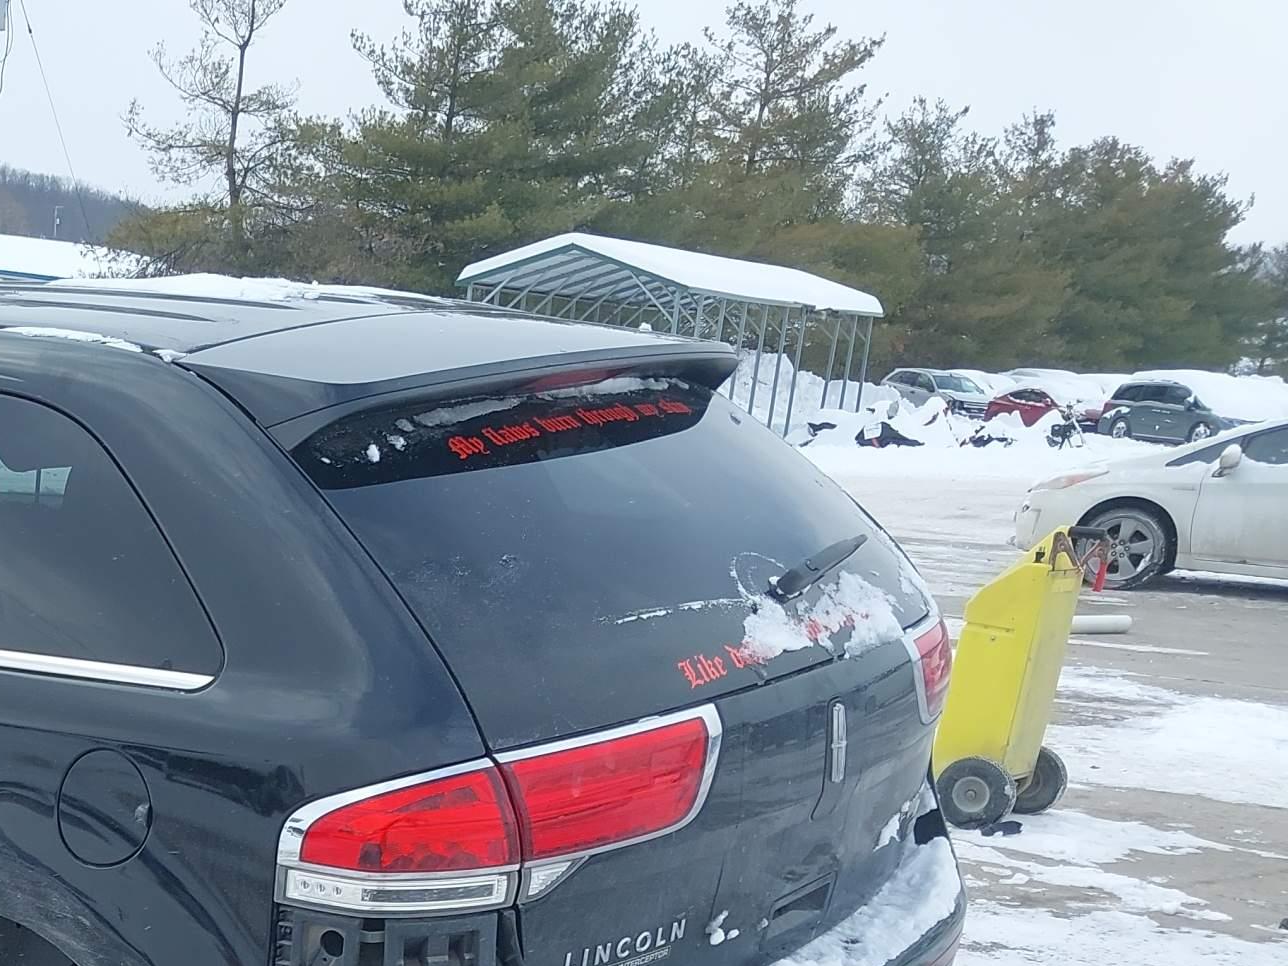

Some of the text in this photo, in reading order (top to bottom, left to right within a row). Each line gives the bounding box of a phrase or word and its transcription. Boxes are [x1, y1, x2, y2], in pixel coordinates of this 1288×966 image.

[448, 436, 490, 459] My
[481, 422, 540, 447] flaws
[532, 416, 582, 433] burn
[576, 403, 640, 426] through
[678, 652, 728, 688] Like
